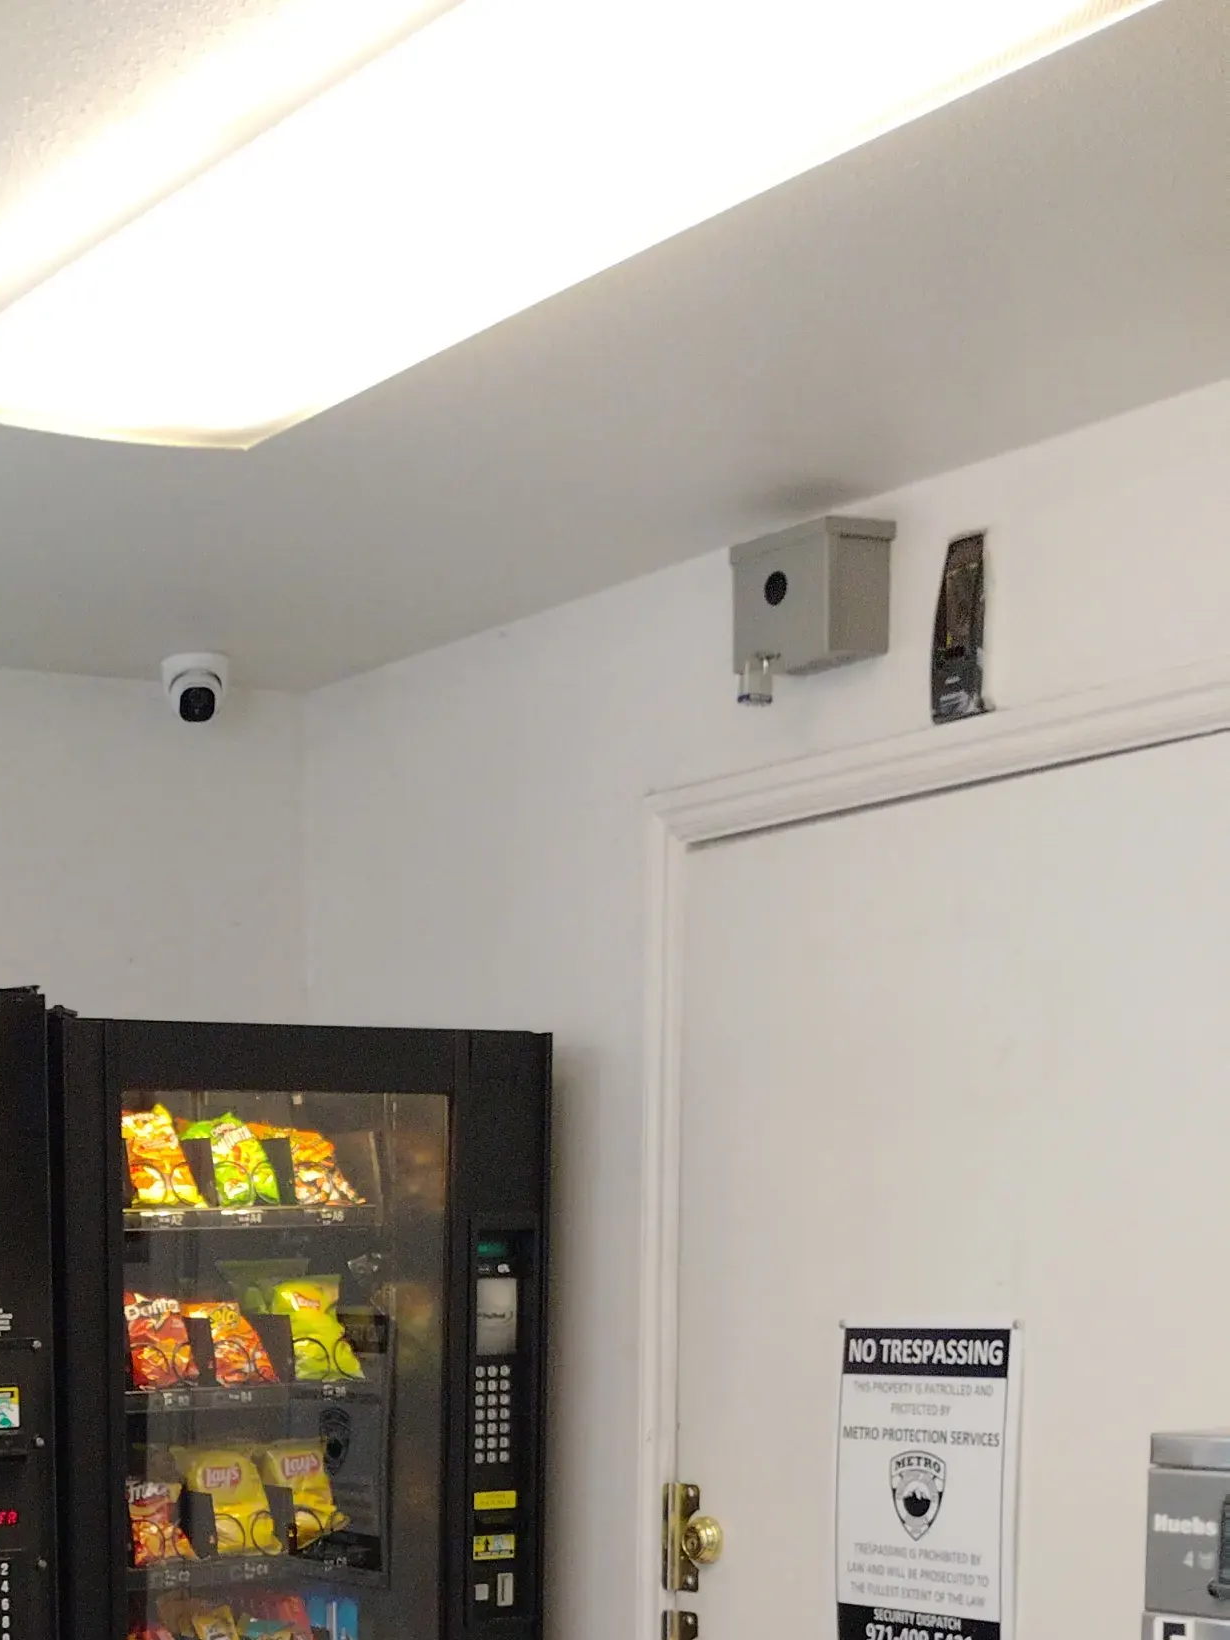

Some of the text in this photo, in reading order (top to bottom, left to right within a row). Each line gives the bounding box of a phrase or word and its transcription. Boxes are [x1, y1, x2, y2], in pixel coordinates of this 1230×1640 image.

[848, 1338, 1004, 1366] NO TRESPASSING
[854, 1380, 870, 1393] THIS
[924, 1383, 972, 1396] PATROLLED
[974, 1384, 994, 1397] AND
[890, 1402, 952, 1416] PROTECTED BY
[843, 1426, 1000, 1447] METRO PROTECTION SERVICES
[894, 1455, 941, 1474] METRO
[1154, 1514, 1218, 1537] Huebs
[854, 1542, 907, 1559] TRESPASSING
[919, 1549, 968, 1565] PROHIBITED
[971, 1553, 982, 1566] BY
[0, 1562, 9, 1576] 2
[847, 1562, 989, 1588] LAW AND WILL BE PROSECUTED TO
[0, 1580, 9, 1593] 4
[851, 1581, 865, 1593] THE
[947, 1592, 964, 1605] THE
[966, 1595, 986, 1608] LAW
[1, 1598, 10, 1611] 6
[1, 1615, 10, 1629] 8
[874, 1608, 962, 1632] SECURITY DISPATCH
